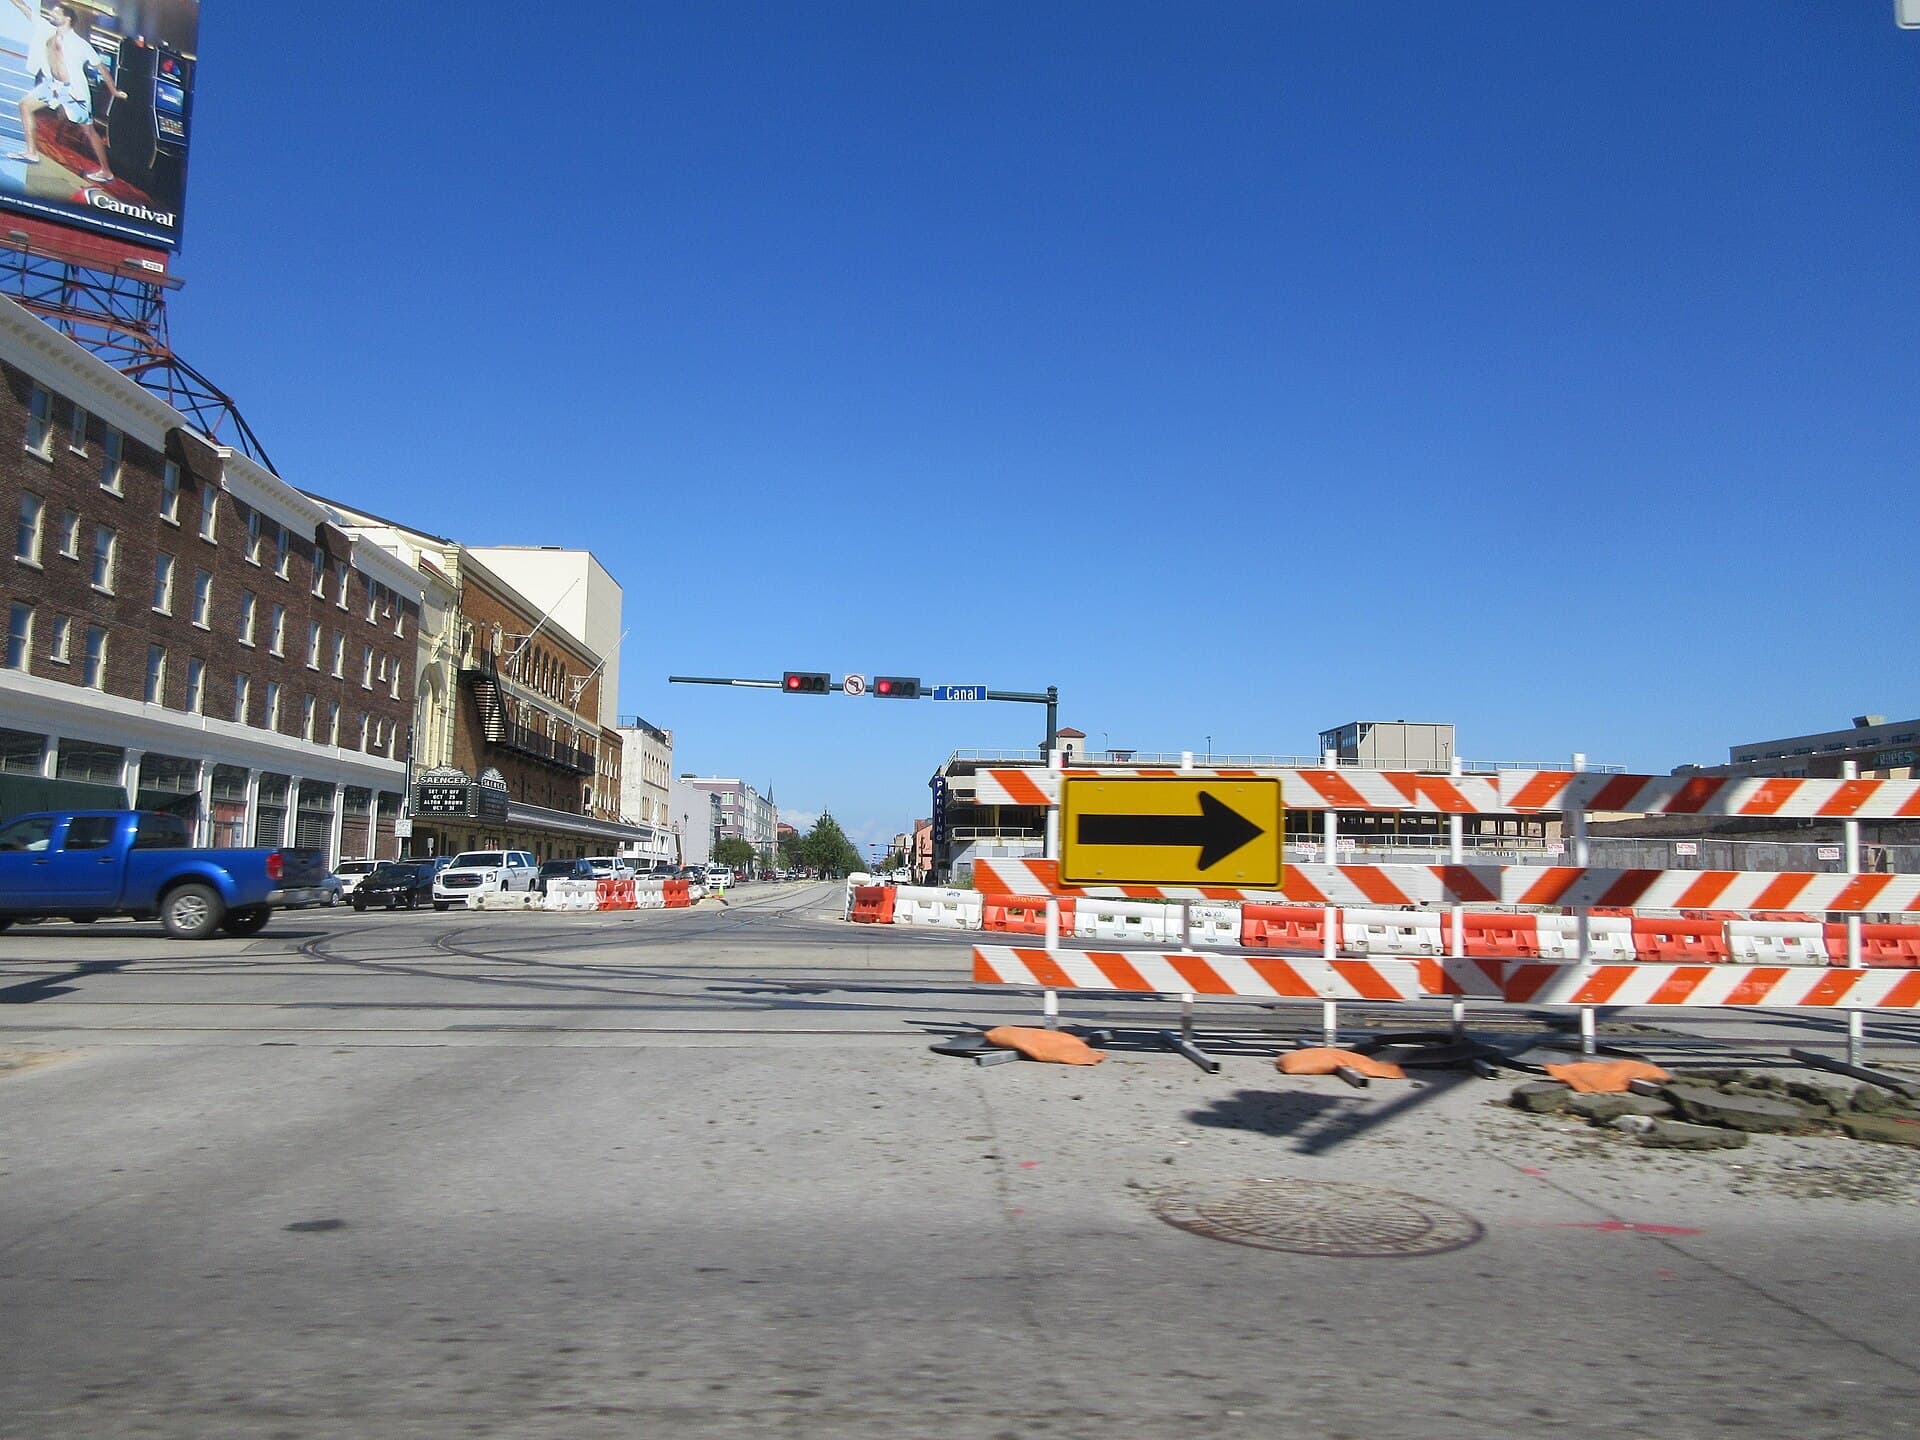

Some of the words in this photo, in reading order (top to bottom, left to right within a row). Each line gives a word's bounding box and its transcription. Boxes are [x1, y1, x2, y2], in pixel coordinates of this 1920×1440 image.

[94, 195, 174, 227] Carnival
[946, 686, 978, 701] Canal
[420, 776, 467, 784] SAENGER
